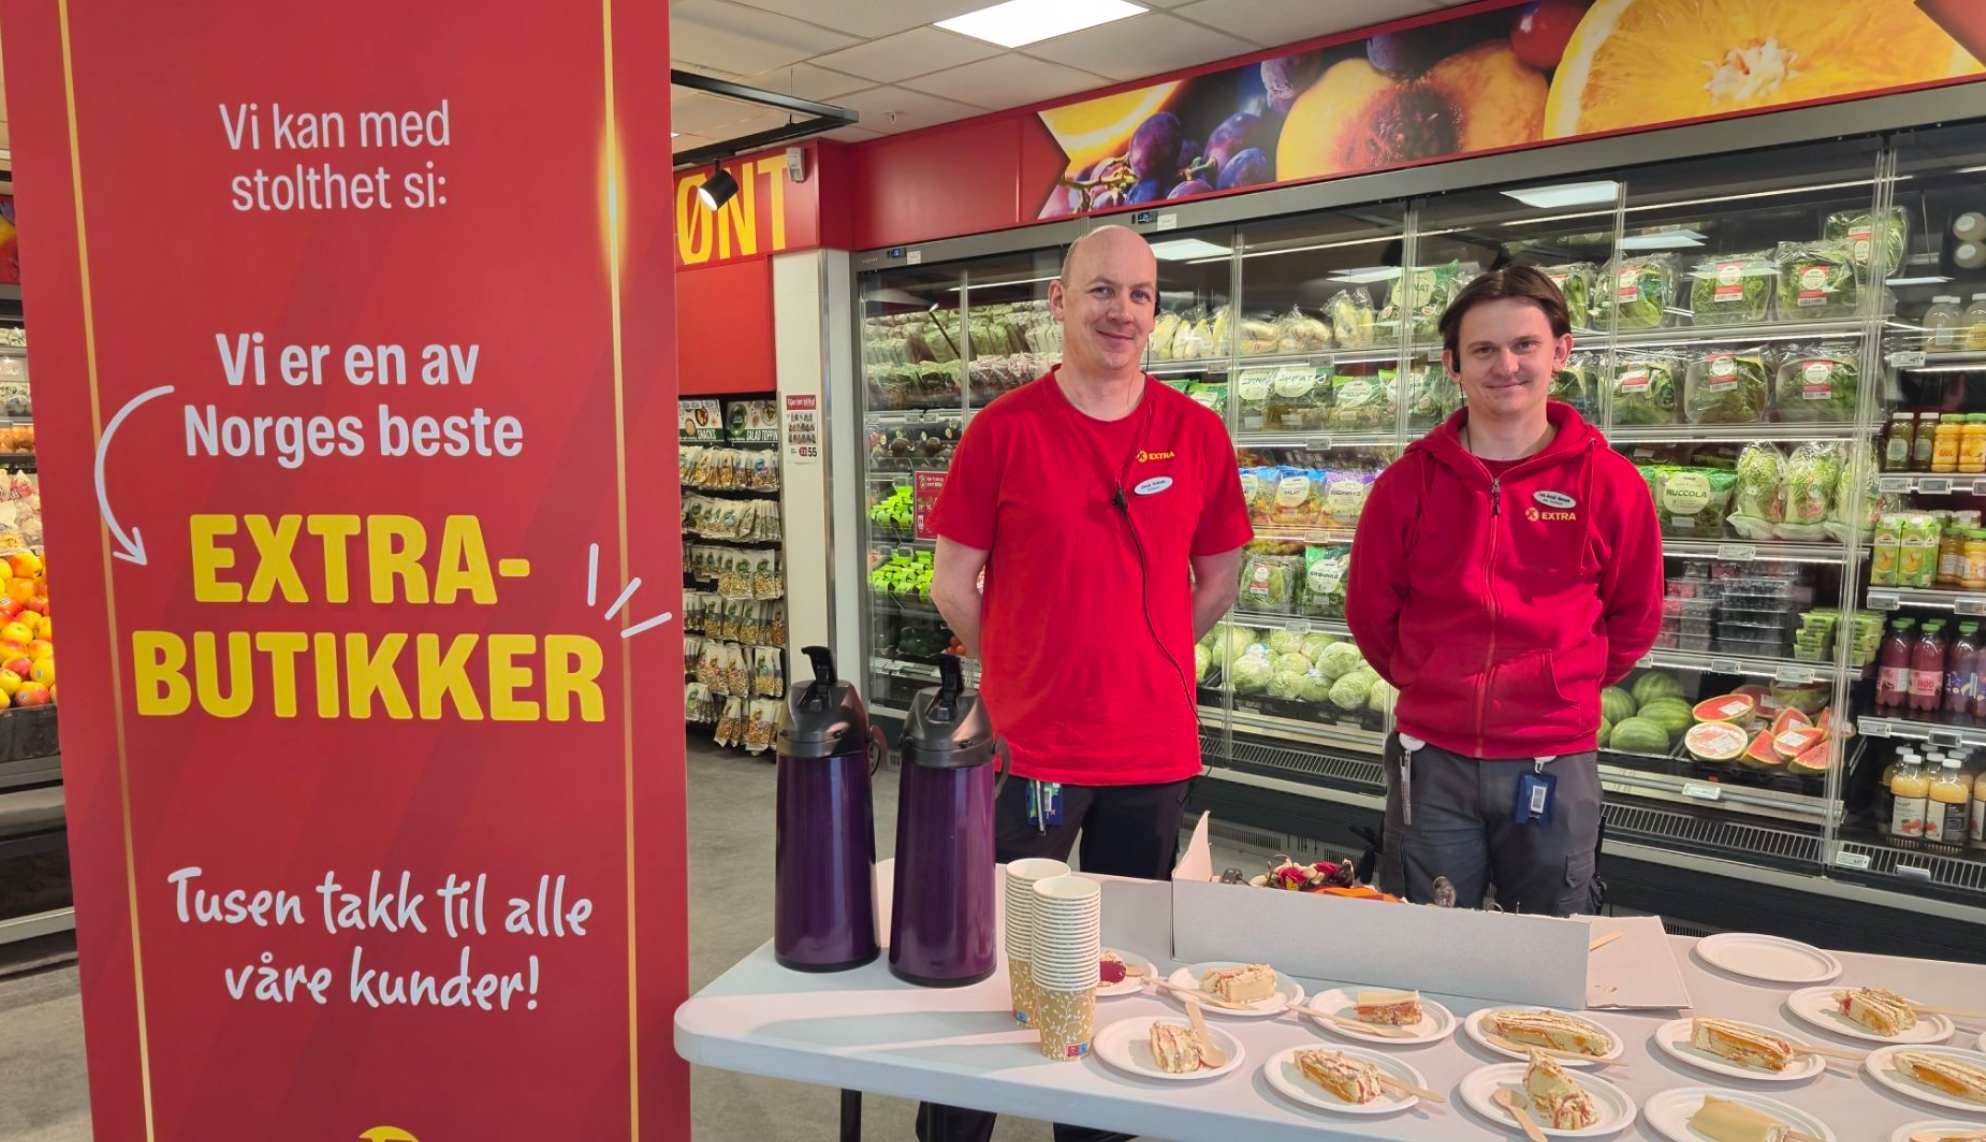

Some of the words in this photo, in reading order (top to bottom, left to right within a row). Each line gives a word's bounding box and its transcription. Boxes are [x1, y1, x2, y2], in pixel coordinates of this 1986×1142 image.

[220, 103, 259, 150] Vi
[273, 103, 345, 149] kan
[360, 99, 450, 148] med
[232, 163, 392, 211] stolthet
[404, 161, 447, 209] si:
[216, 332, 266, 386] Vi
[280, 344, 330, 386] er
[344, 344, 407, 386] en
[421, 344, 480, 386] av
[184, 404, 365, 469] Norges
[378, 404, 523, 457] beste
[697, 429, 717, 440] SNACKS
[1149, 450, 1176, 460] EXTRA
[1541, 512, 1577, 521] EXTRA
[1666, 489, 1708, 498] RUCCOLA
[189, 514, 531, 605] EXTRA-
[132, 630, 606, 722] BUTIKKER
[167, 866, 305, 927] Tusen
[315, 869, 427, 935] takk
[436, 872, 487, 938] til
[505, 874, 593, 937] alle
[225, 951, 332, 1004] våre
[350, 945, 539, 1011] kunder!
